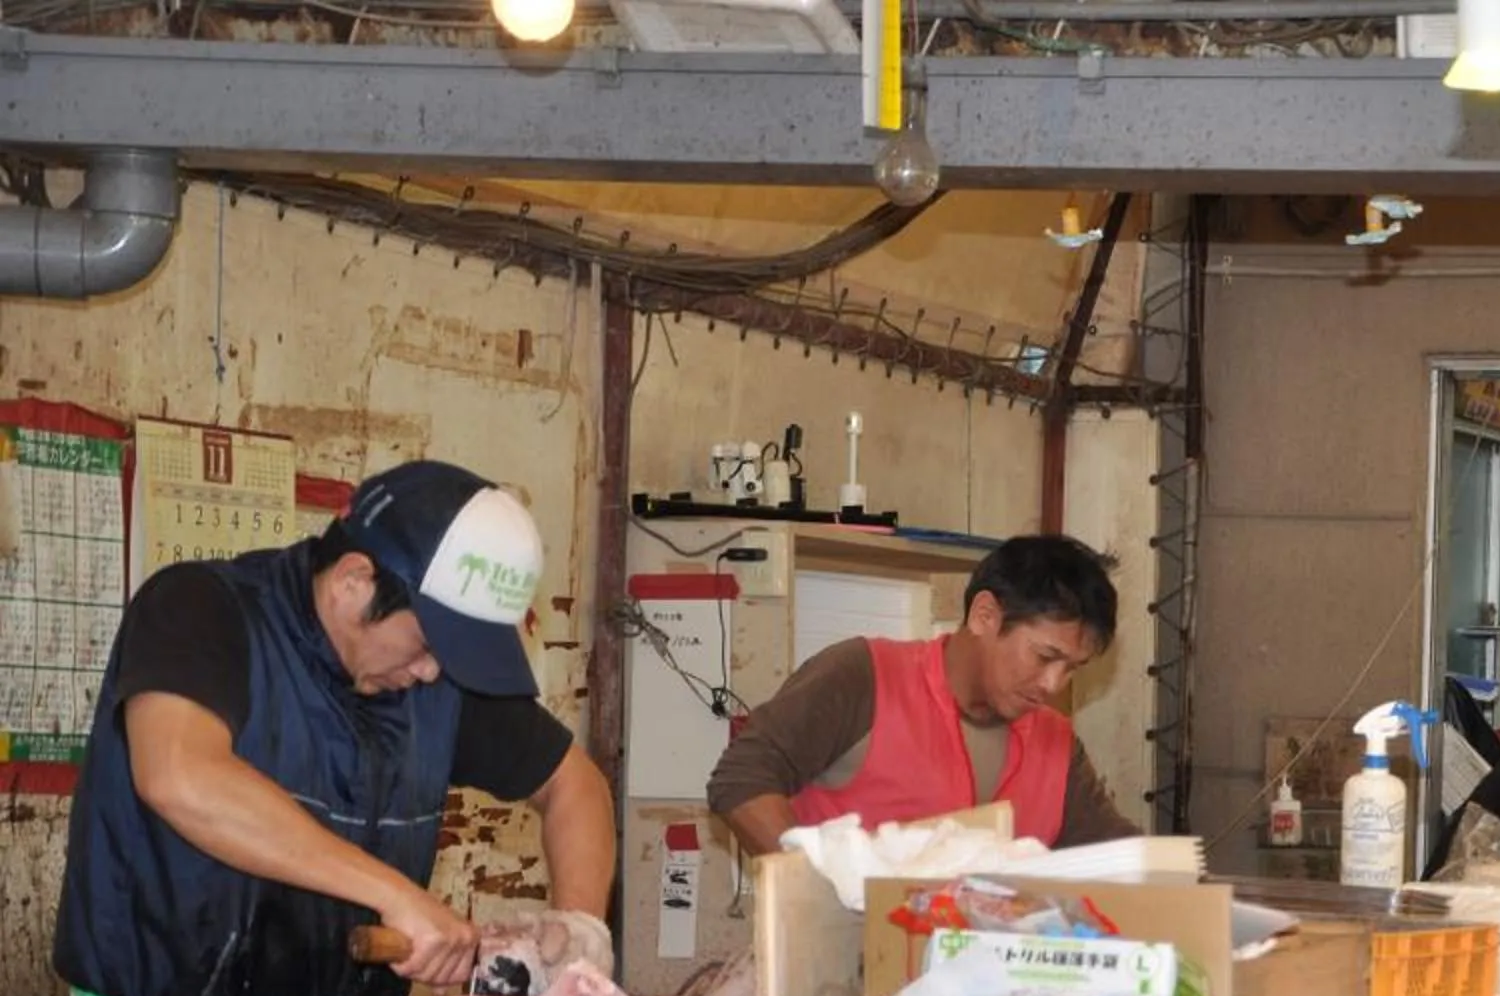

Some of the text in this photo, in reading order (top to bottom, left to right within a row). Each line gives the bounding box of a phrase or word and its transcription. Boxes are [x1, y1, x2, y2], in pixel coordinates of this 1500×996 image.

[207, 445, 227, 476] 11
[176, 503, 283, 534] 1 2 3 4 5 6
